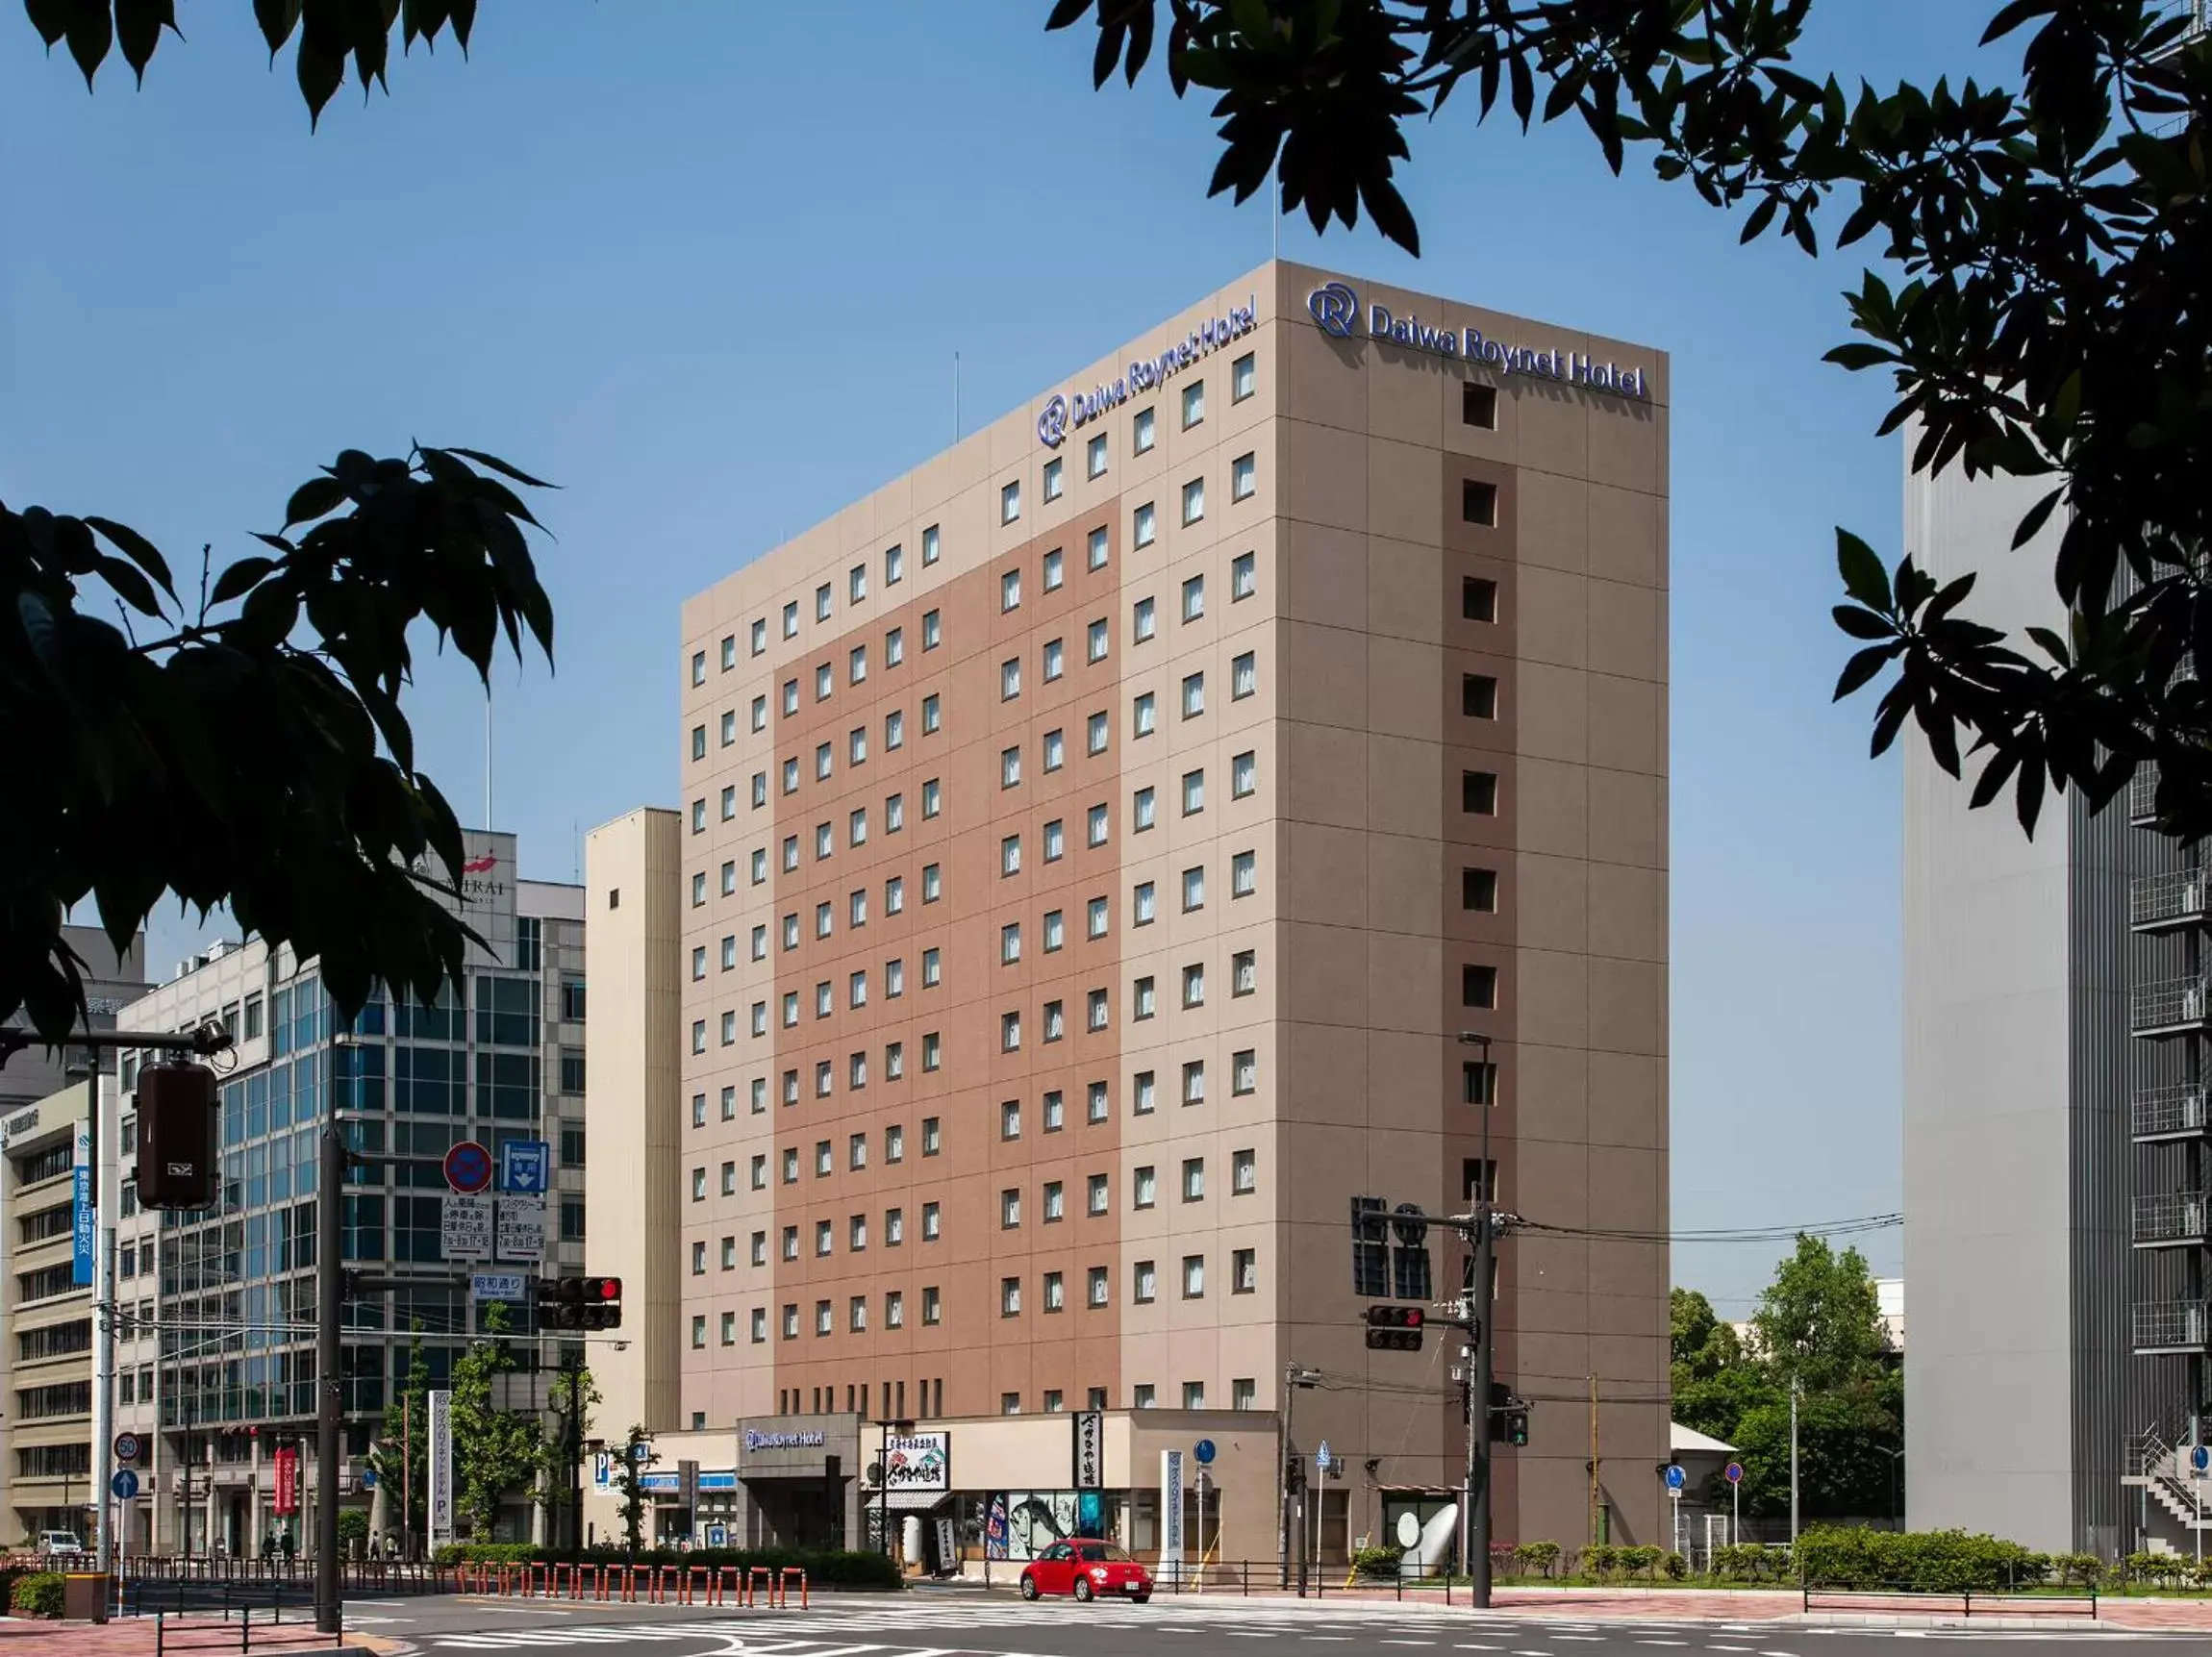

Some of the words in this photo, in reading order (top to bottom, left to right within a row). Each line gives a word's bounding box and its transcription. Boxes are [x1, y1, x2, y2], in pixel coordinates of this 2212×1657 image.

[1072, 380, 1125, 424] Daiwa
[1129, 332, 1199, 388] Roynet
[1201, 294, 1257, 347] Hotel
[1369, 305, 1456, 354] Daiwa
[1462, 326, 1564, 378] Roynet
[1569, 350, 1645, 396] Hotel
[474, 1276, 520, 1289] 昭和通り
[119, 1439, 135, 1452] 50
[597, 1452, 607, 1479] P
[437, 1500, 446, 1513] P
